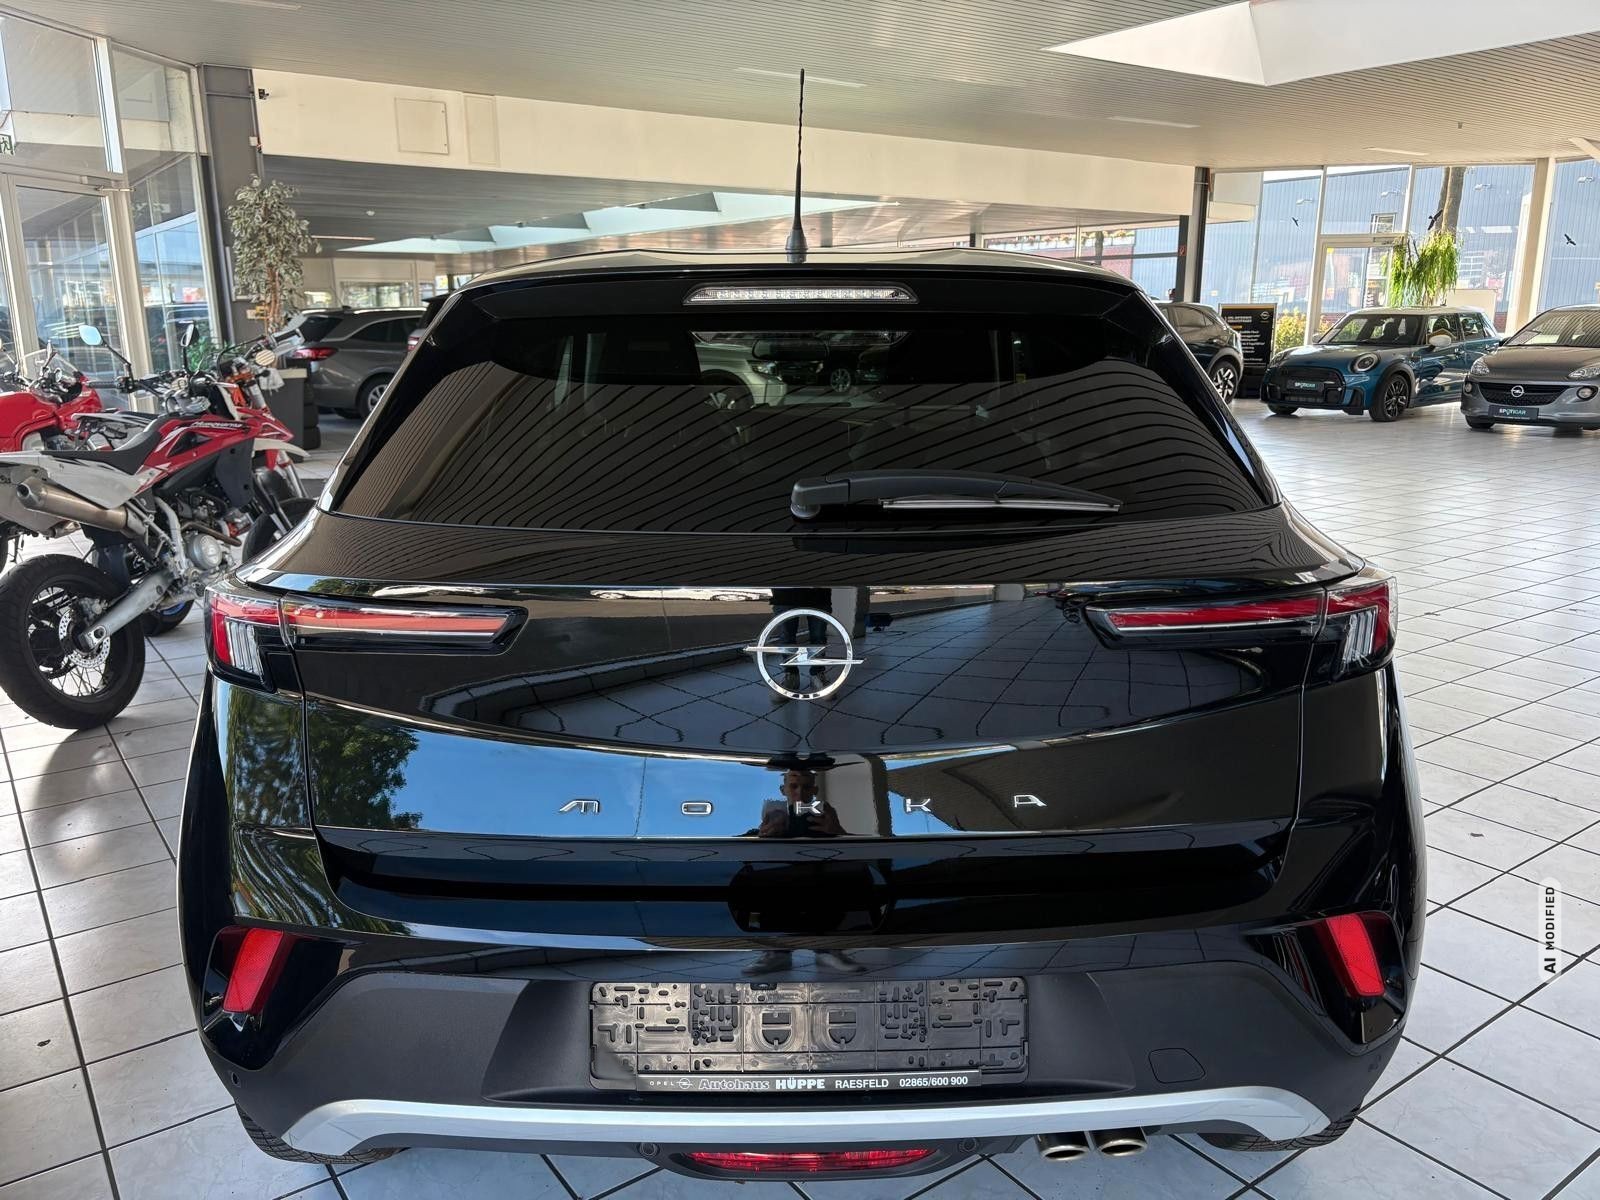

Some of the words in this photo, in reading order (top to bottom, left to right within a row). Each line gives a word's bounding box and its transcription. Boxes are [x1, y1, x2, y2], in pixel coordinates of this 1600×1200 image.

[1499, 408, 1527, 416] SPOTICAR
[558, 793, 1047, 815] MOKKA
[699, 1078, 770, 1090] Autohaus
[775, 1076, 826, 1090] HÜPPE
[835, 1078, 889, 1089] RAESFELD
[899, 1076, 949, 1088] 02865/600
[950, 1075, 968, 1086] 900
